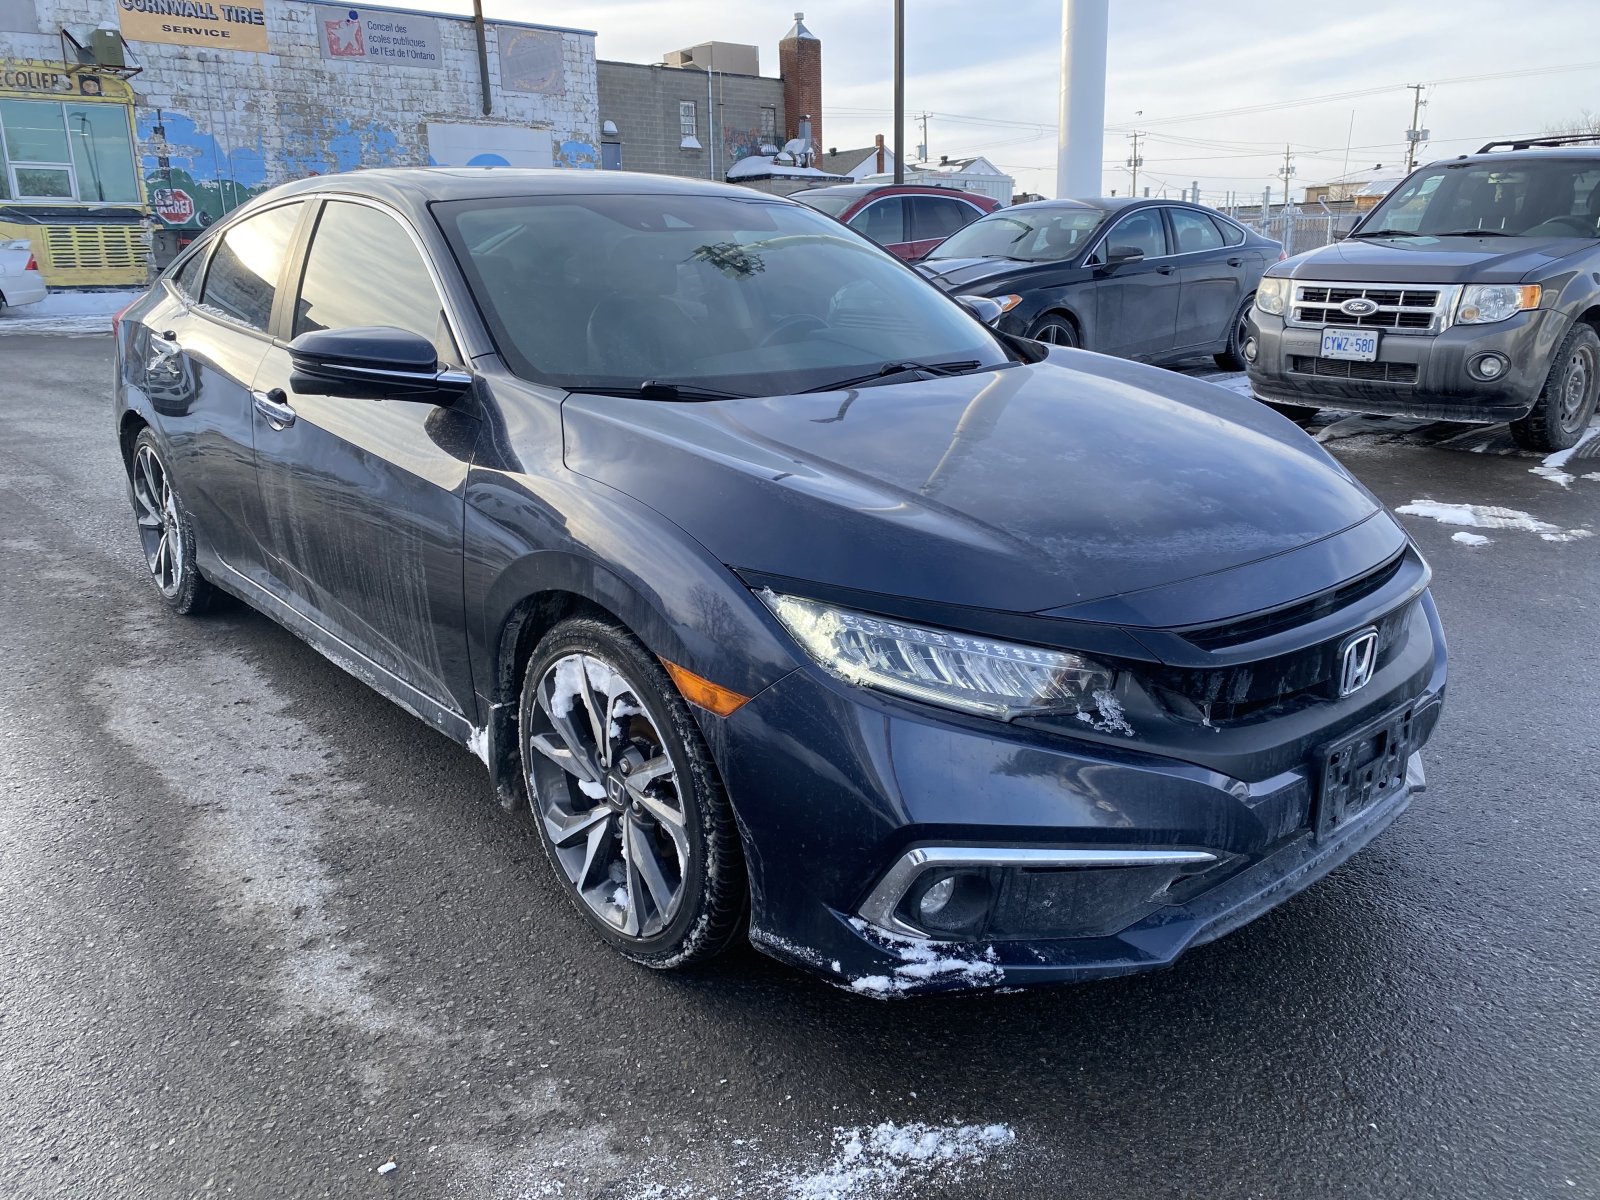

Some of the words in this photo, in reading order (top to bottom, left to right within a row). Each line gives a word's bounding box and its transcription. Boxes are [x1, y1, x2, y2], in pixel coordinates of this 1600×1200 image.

[119, 0, 218, 20] CORNWALL
[220, 4, 264, 25] TIRE
[162, 24, 230, 38] SERVICE
[367, 21, 393, 32] Conseil
[395, 24, 407, 33] des
[392, 36, 426, 48] publiques
[370, 46, 379, 55] de
[380, 46, 396, 57] l'Est
[397, 49, 406, 57] de
[406, 49, 435, 60] l'Ontario
[1348, 302, 1367, 311] Ford
